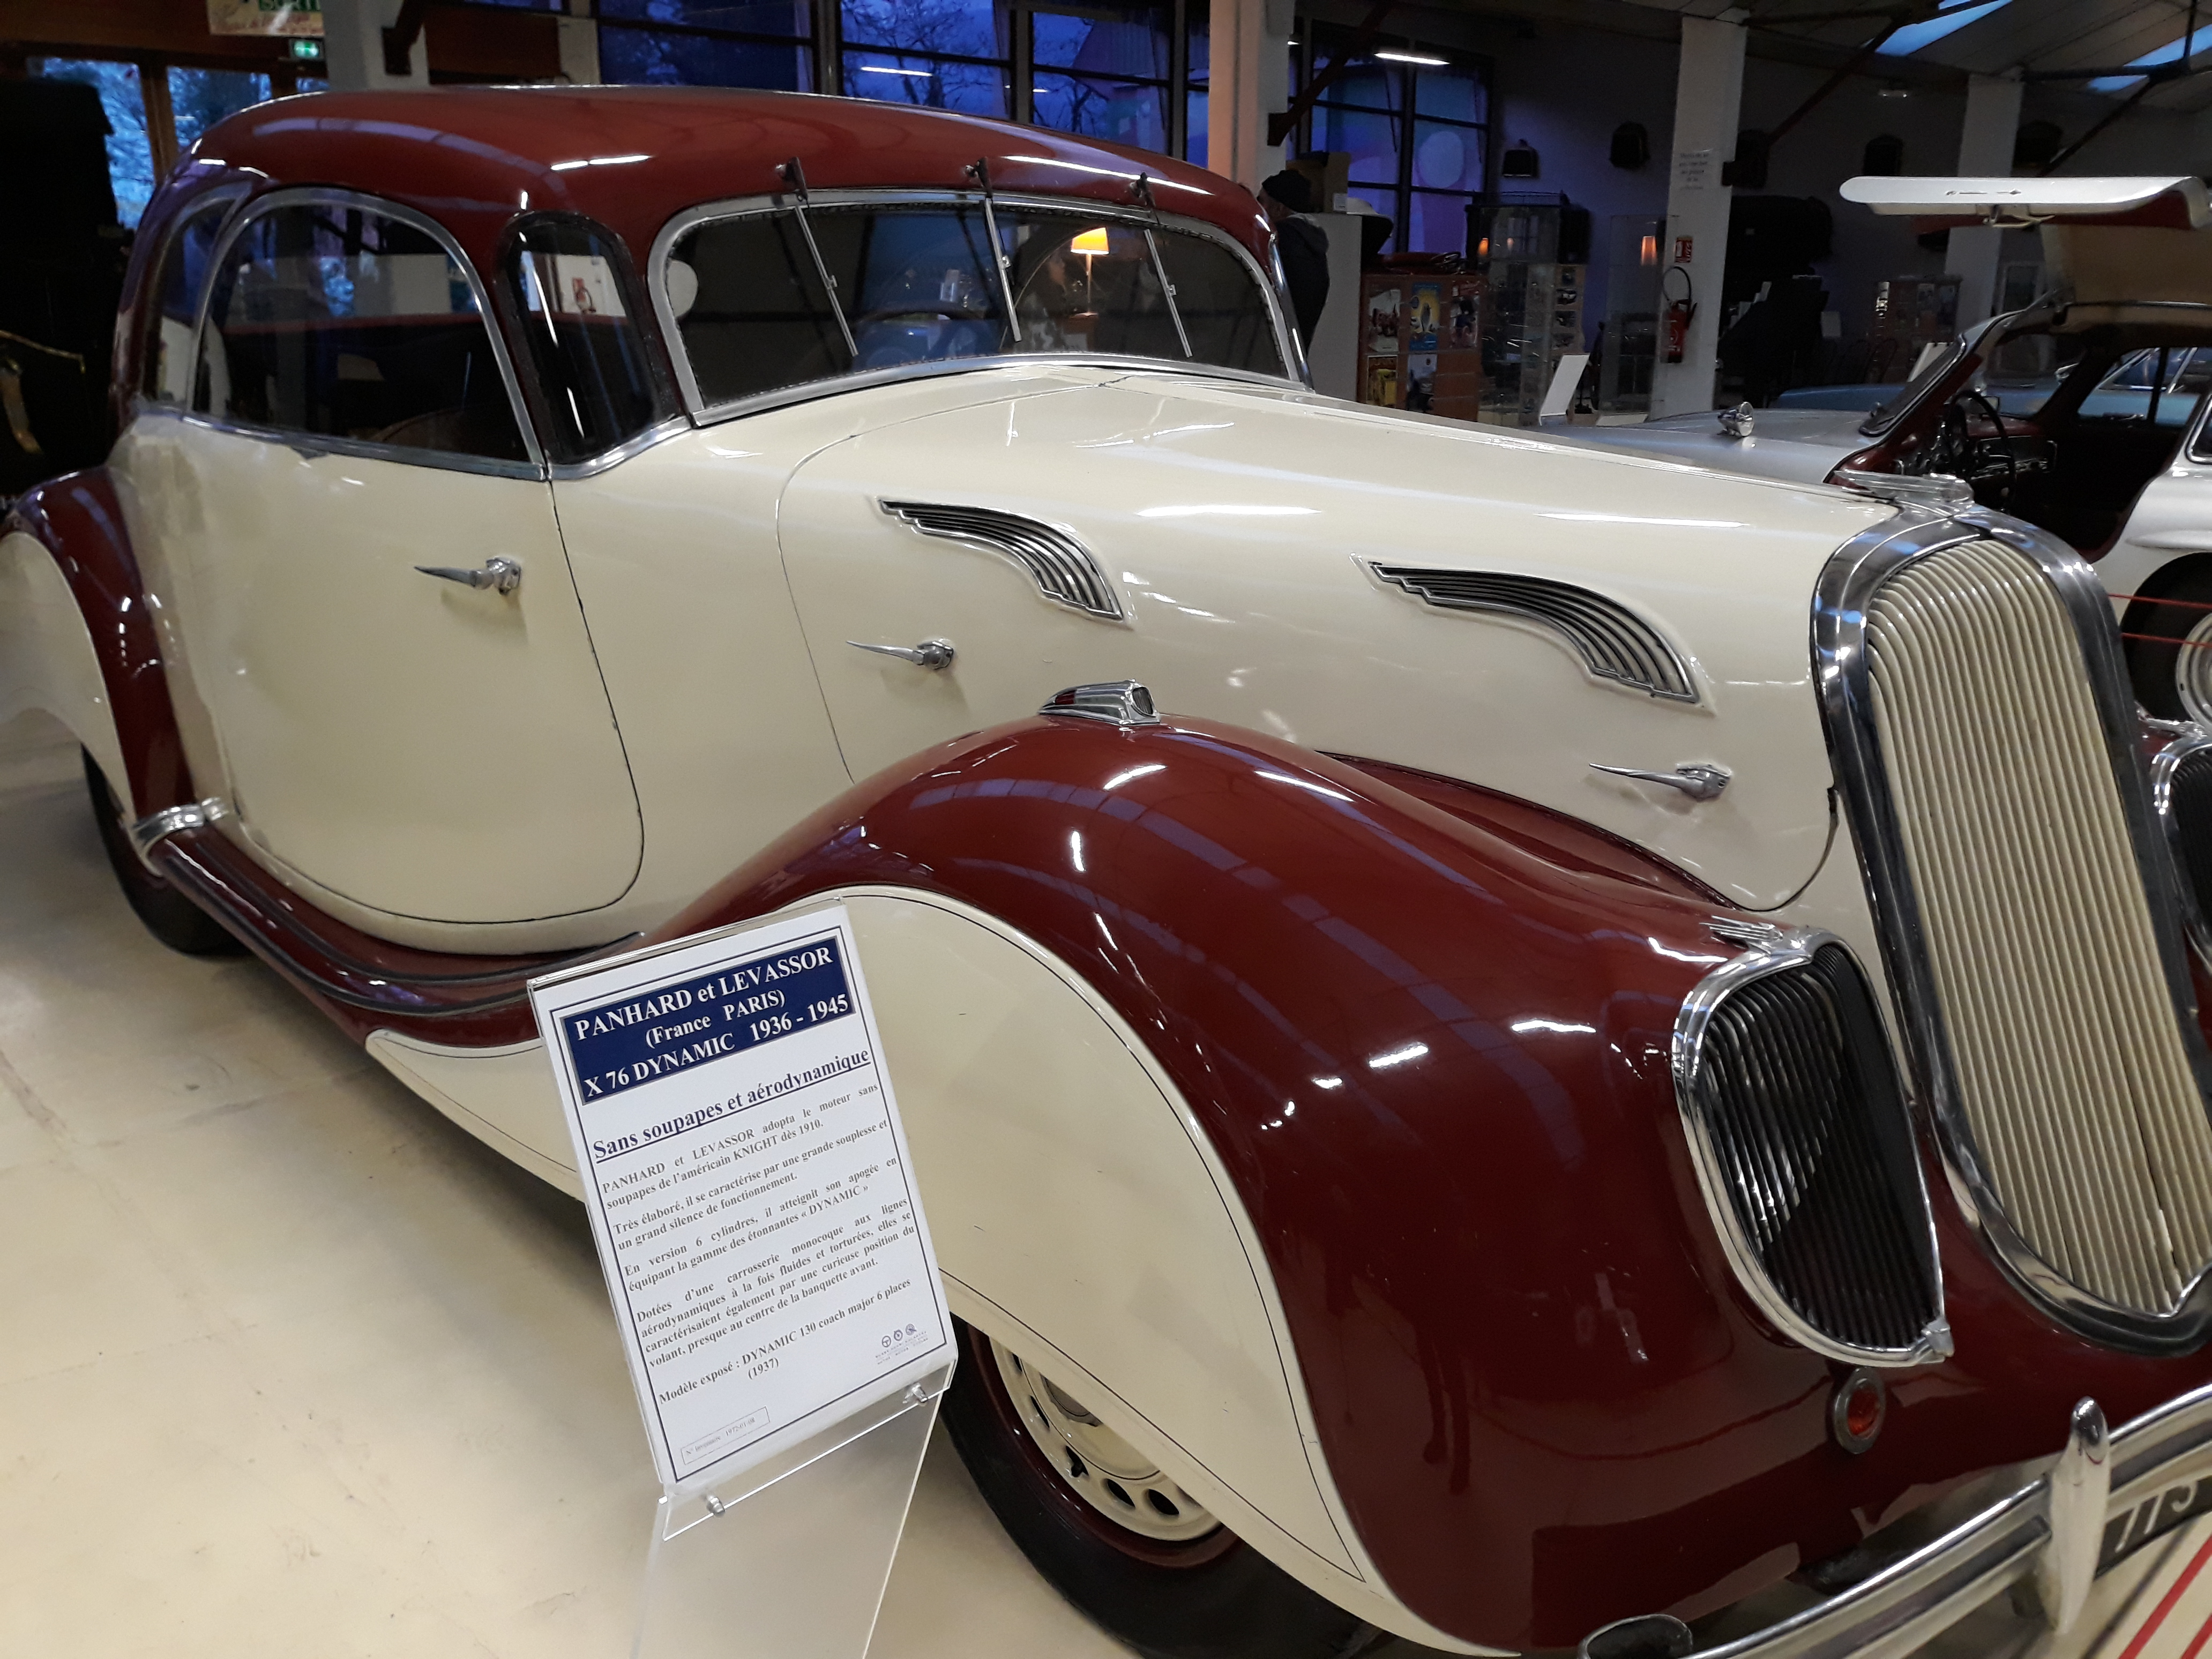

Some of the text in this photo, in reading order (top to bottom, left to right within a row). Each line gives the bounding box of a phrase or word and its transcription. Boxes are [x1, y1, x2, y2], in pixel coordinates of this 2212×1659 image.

[574, 947, 833, 1041] PANHARD et LEVASSOR
[584, 1075, 604, 1097] X
[605, 1067, 630, 1089] 76
[631, 1032, 735, 1081] DYNAMIC
[749, 1011, 793, 1042] 1936
[807, 993, 849, 1022] 1945
[645, 989, 786, 1049] (France PARIS)
[593, 1050, 869, 1159] Sans soupapes et aérodynamique
[602, 1085, 879, 1194] PANHARD et LEVASSOR adopta le moteur sans
[607, 1185, 657, 1210] soupapes
[658, 1178, 671, 1190] de
[733, 1134, 778, 1161] KNIGHT
[781, 1130, 797, 1142] dès
[798, 1118, 824, 1135] 1910.
[612, 1119, 888, 1235] Très élaboré, il se caractérise par une grande souplesse et
[617, 1172, 798, 1251] un grand silence de fonctionnement.
[624, 1157, 898, 1277] En version 6 cylindres, il atteignit son apogée en
[629, 1265, 676, 1292] équipant
[676, 1260, 689, 1272] la
[690, 1245, 728, 1269] gamme
[729, 1236, 746, 1250] des
[748, 1214, 799, 1242] étonnantes
[808, 1185, 860, 1215] DYNAMIC
[636, 1303, 672, 1323] Dotées
[727, 1253, 780, 1284] carrosserie
[791, 1227, 844, 1255] monocoque
[854, 1214, 872, 1227] aux
[880, 1198, 908, 1215] lignes
[641, 1212, 911, 1339] aérodynamiques à la fois fluides et torturées, elles se
[645, 1225, 915, 1354] caractérisaient également par une curieuse position du
[648, 1257, 879, 1368] volant, presque au centre de la banquette avant.
[659, 1380, 698, 1405] Modèle
[700, 1361, 733, 1386] exposé
[741, 1330, 797, 1365] DYNAMIC
[799, 1321, 817, 1337] 130
[818, 1309, 846, 1328] coach
[847, 1296, 875, 1315] major
[876, 1292, 883, 1301] 6
[884, 1279, 911, 1300] places
[748, 1357, 779, 1380] (1937)
